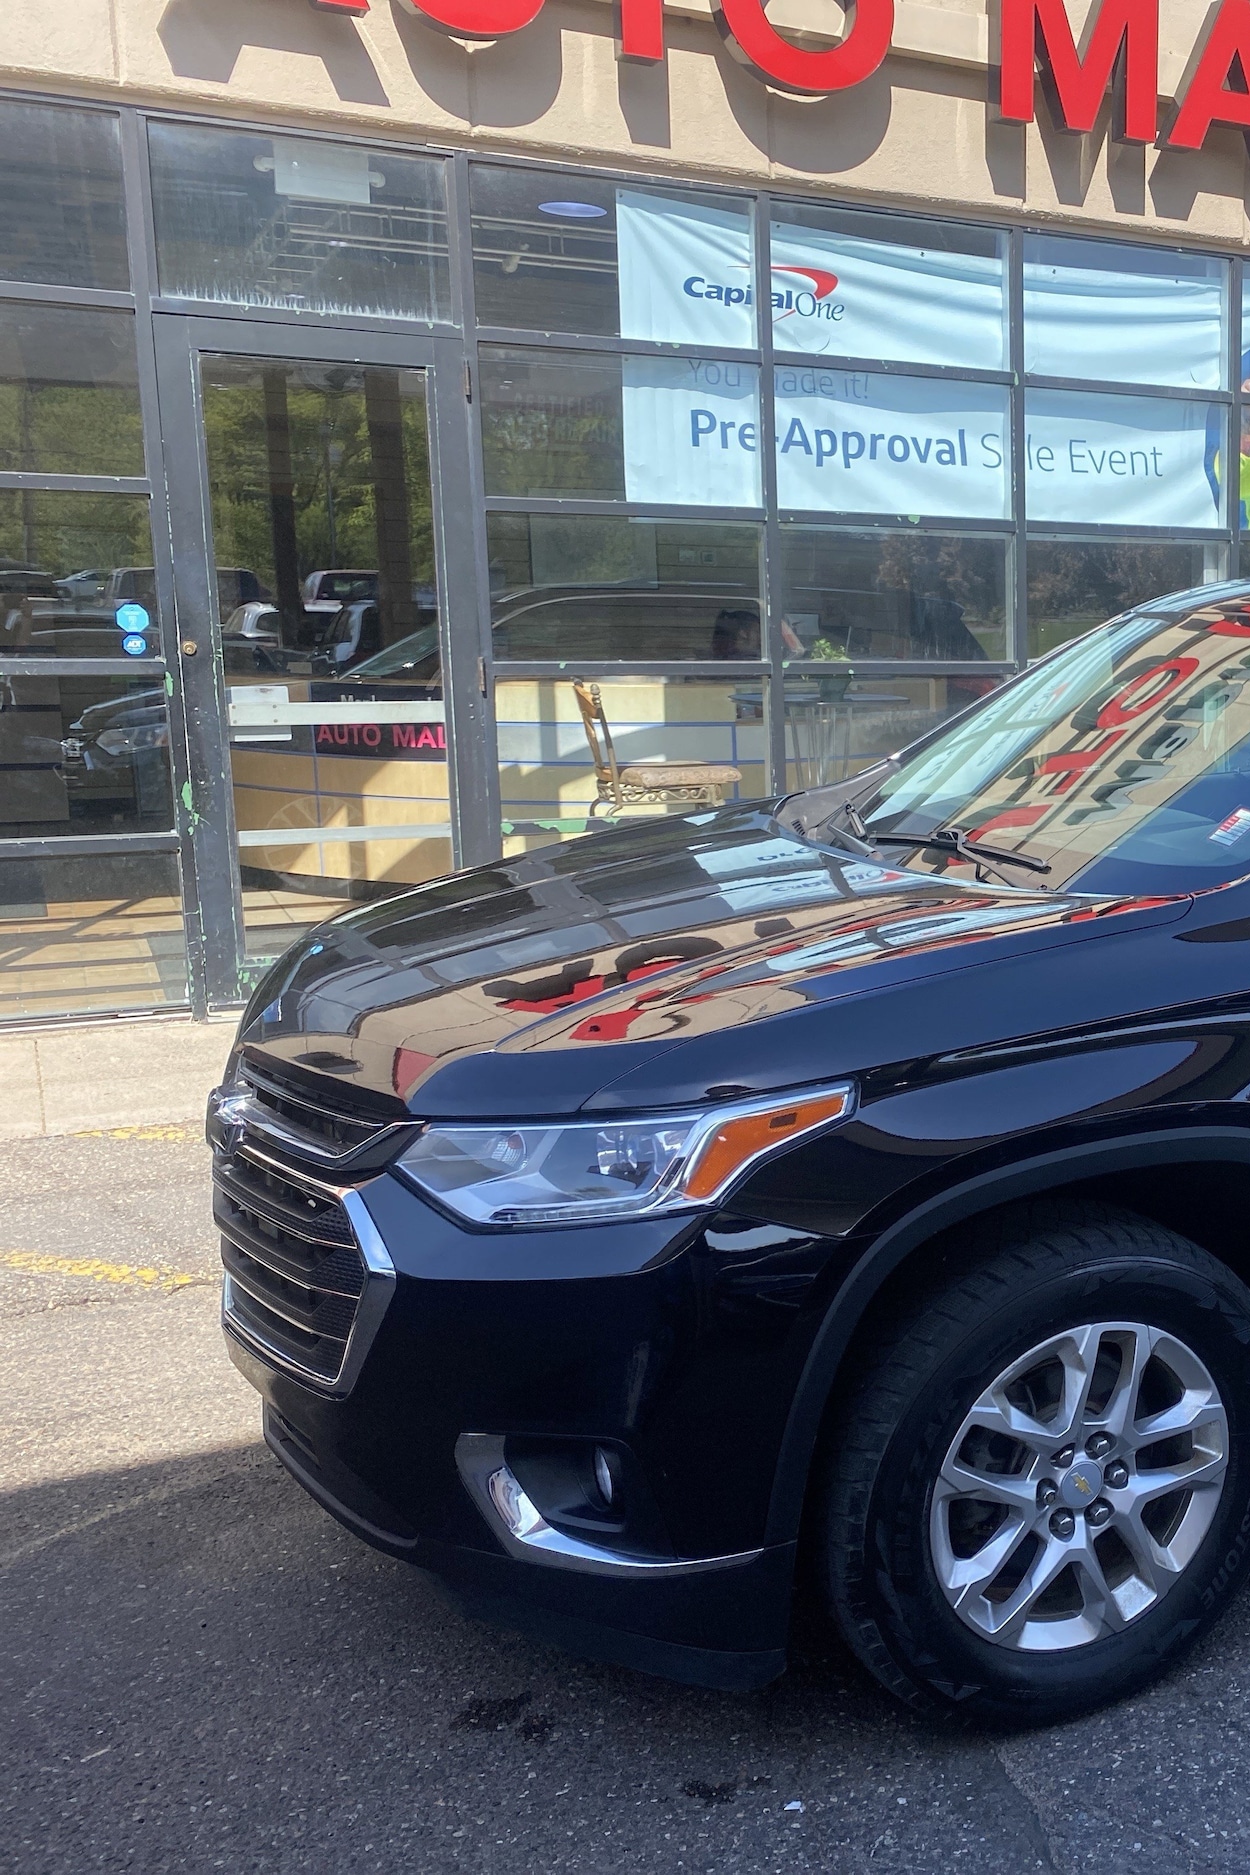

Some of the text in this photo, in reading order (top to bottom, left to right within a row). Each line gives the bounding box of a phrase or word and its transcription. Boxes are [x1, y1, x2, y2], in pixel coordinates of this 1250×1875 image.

[688, 359, 870, 399] You ade it!
[980, 432, 1055, 473] Sle
[1068, 438, 1164, 477] Event
[317, 723, 447, 749] AUTO MAL
